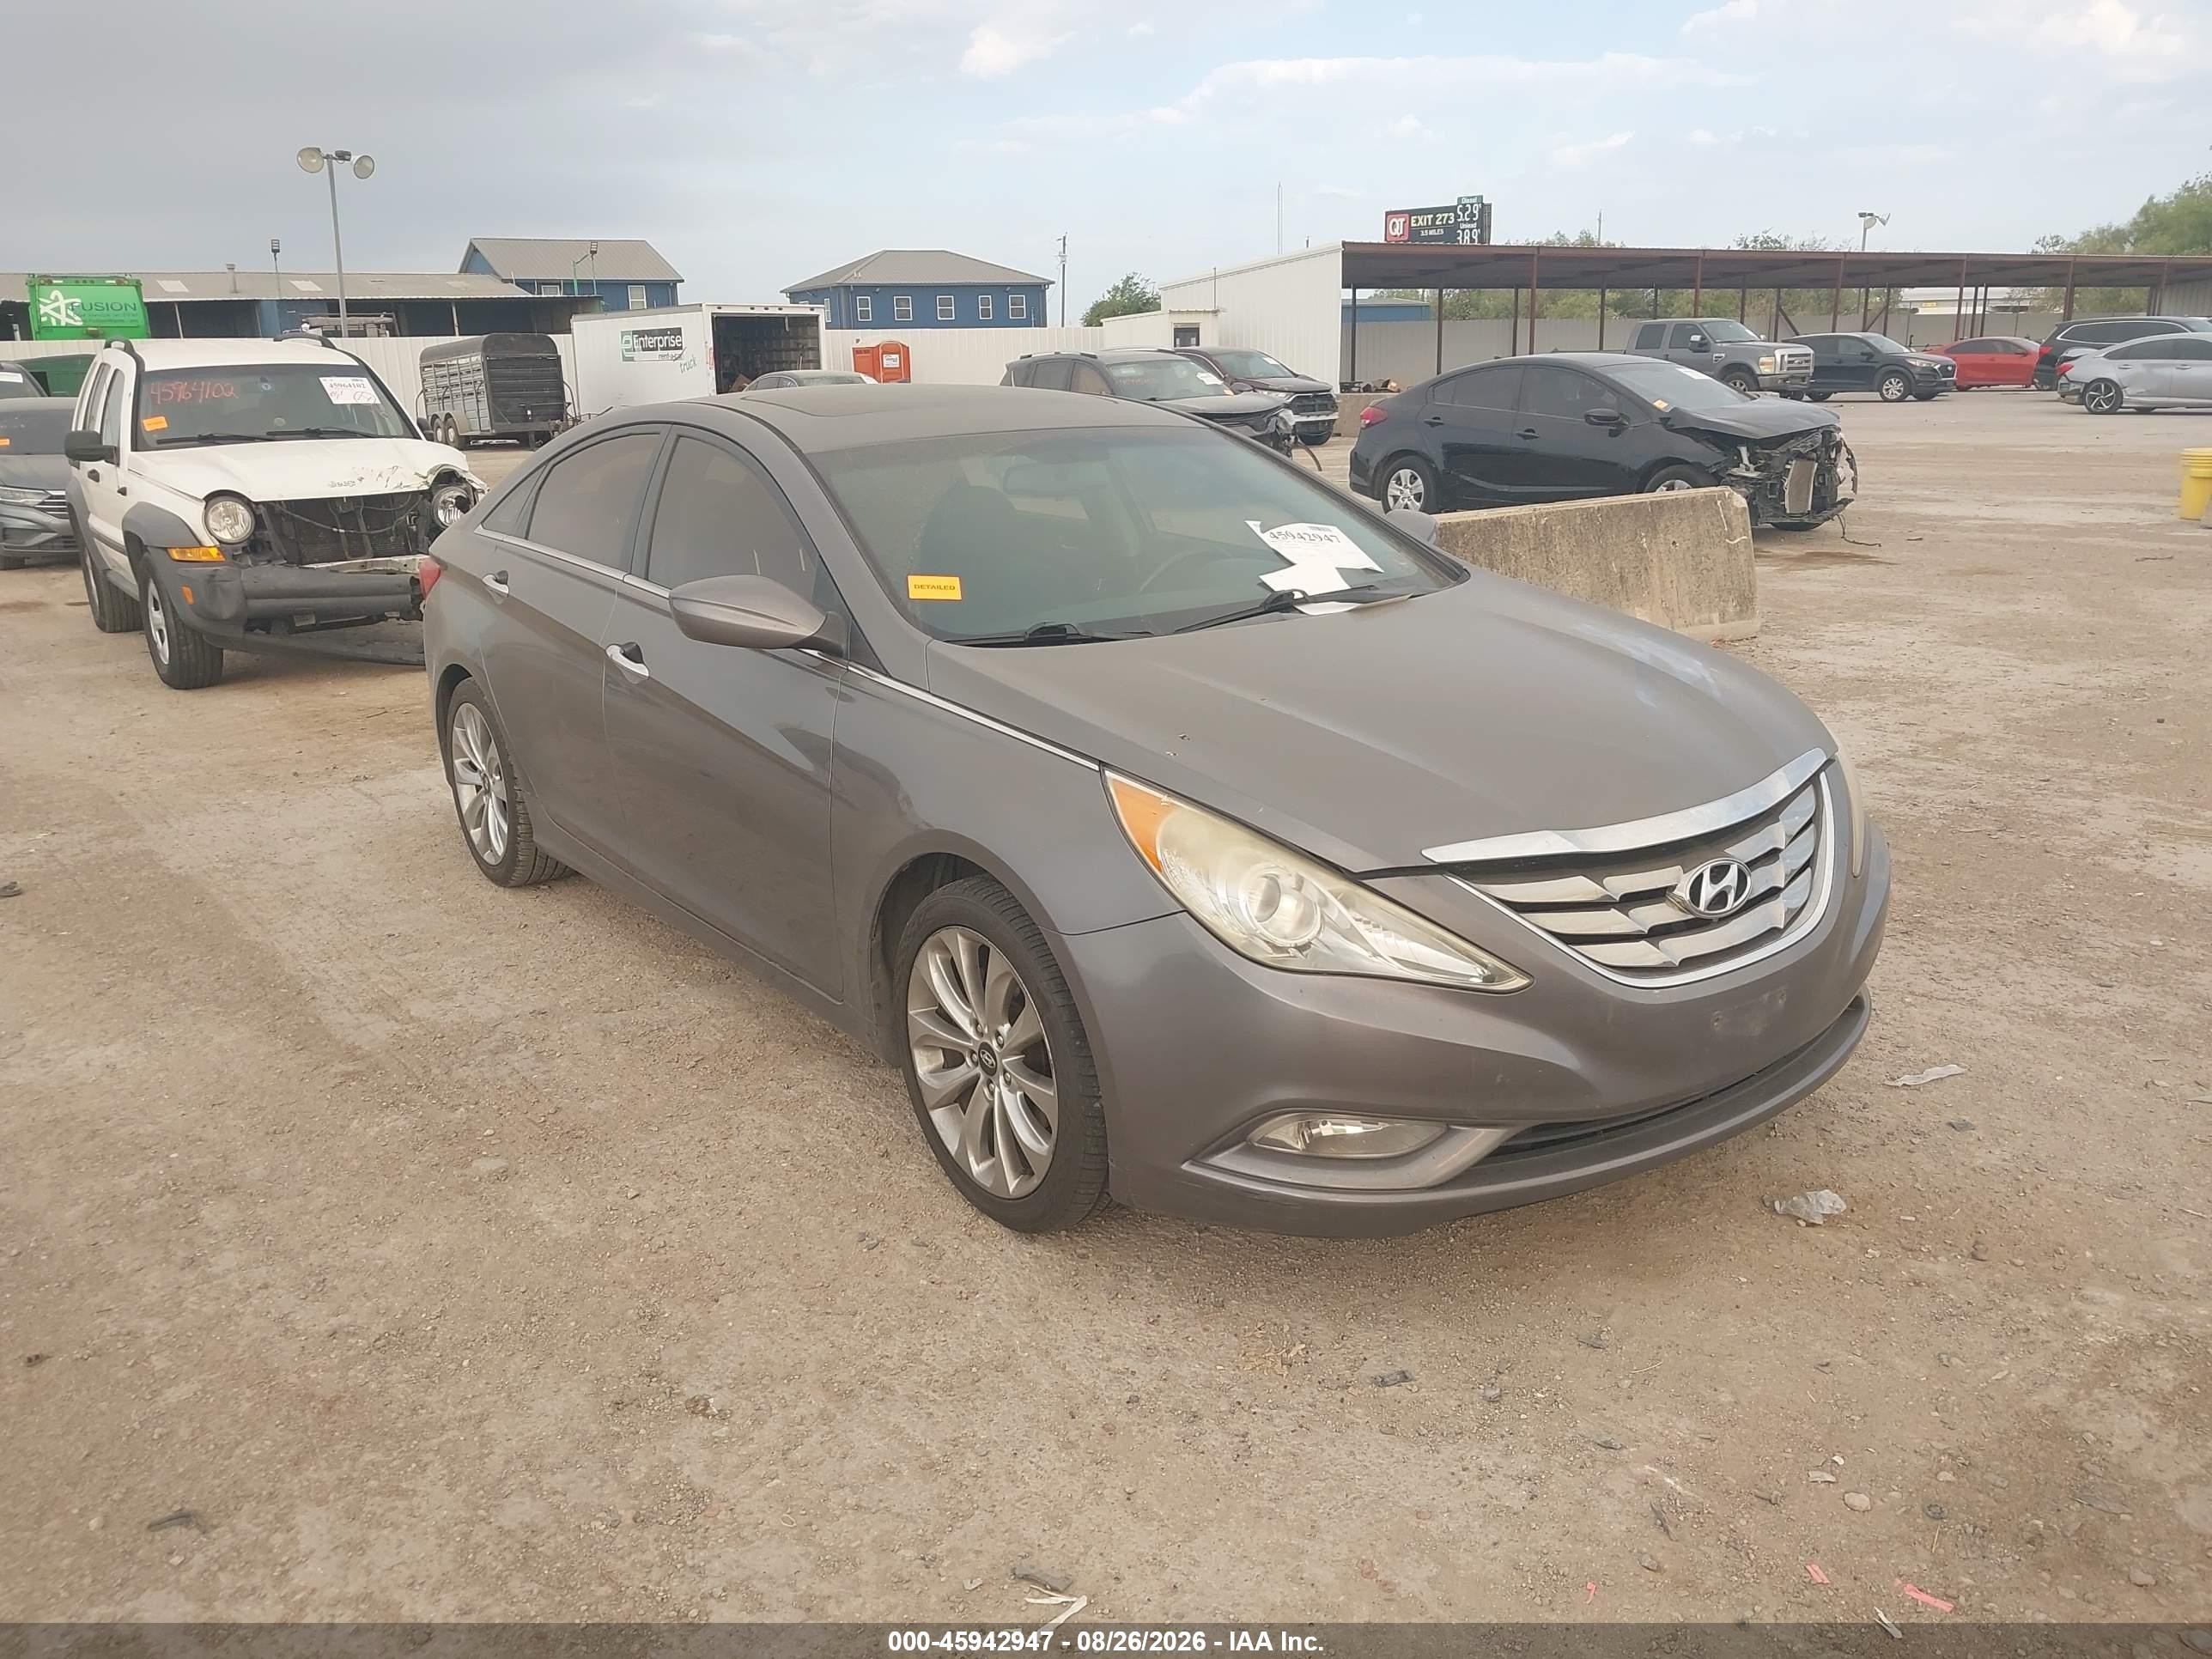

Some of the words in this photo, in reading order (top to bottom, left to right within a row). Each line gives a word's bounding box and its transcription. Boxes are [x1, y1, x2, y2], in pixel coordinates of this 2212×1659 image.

[1389, 217, 1406, 237] QT
[1411, 214, 1433, 228] EXIT
[1435, 212, 1455, 225] 273
[70, 301, 137, 312] FUSION
[633, 331, 683, 352] Enterprise
[680, 354, 697, 374] truck
[1269, 531, 1341, 544] 45942947
